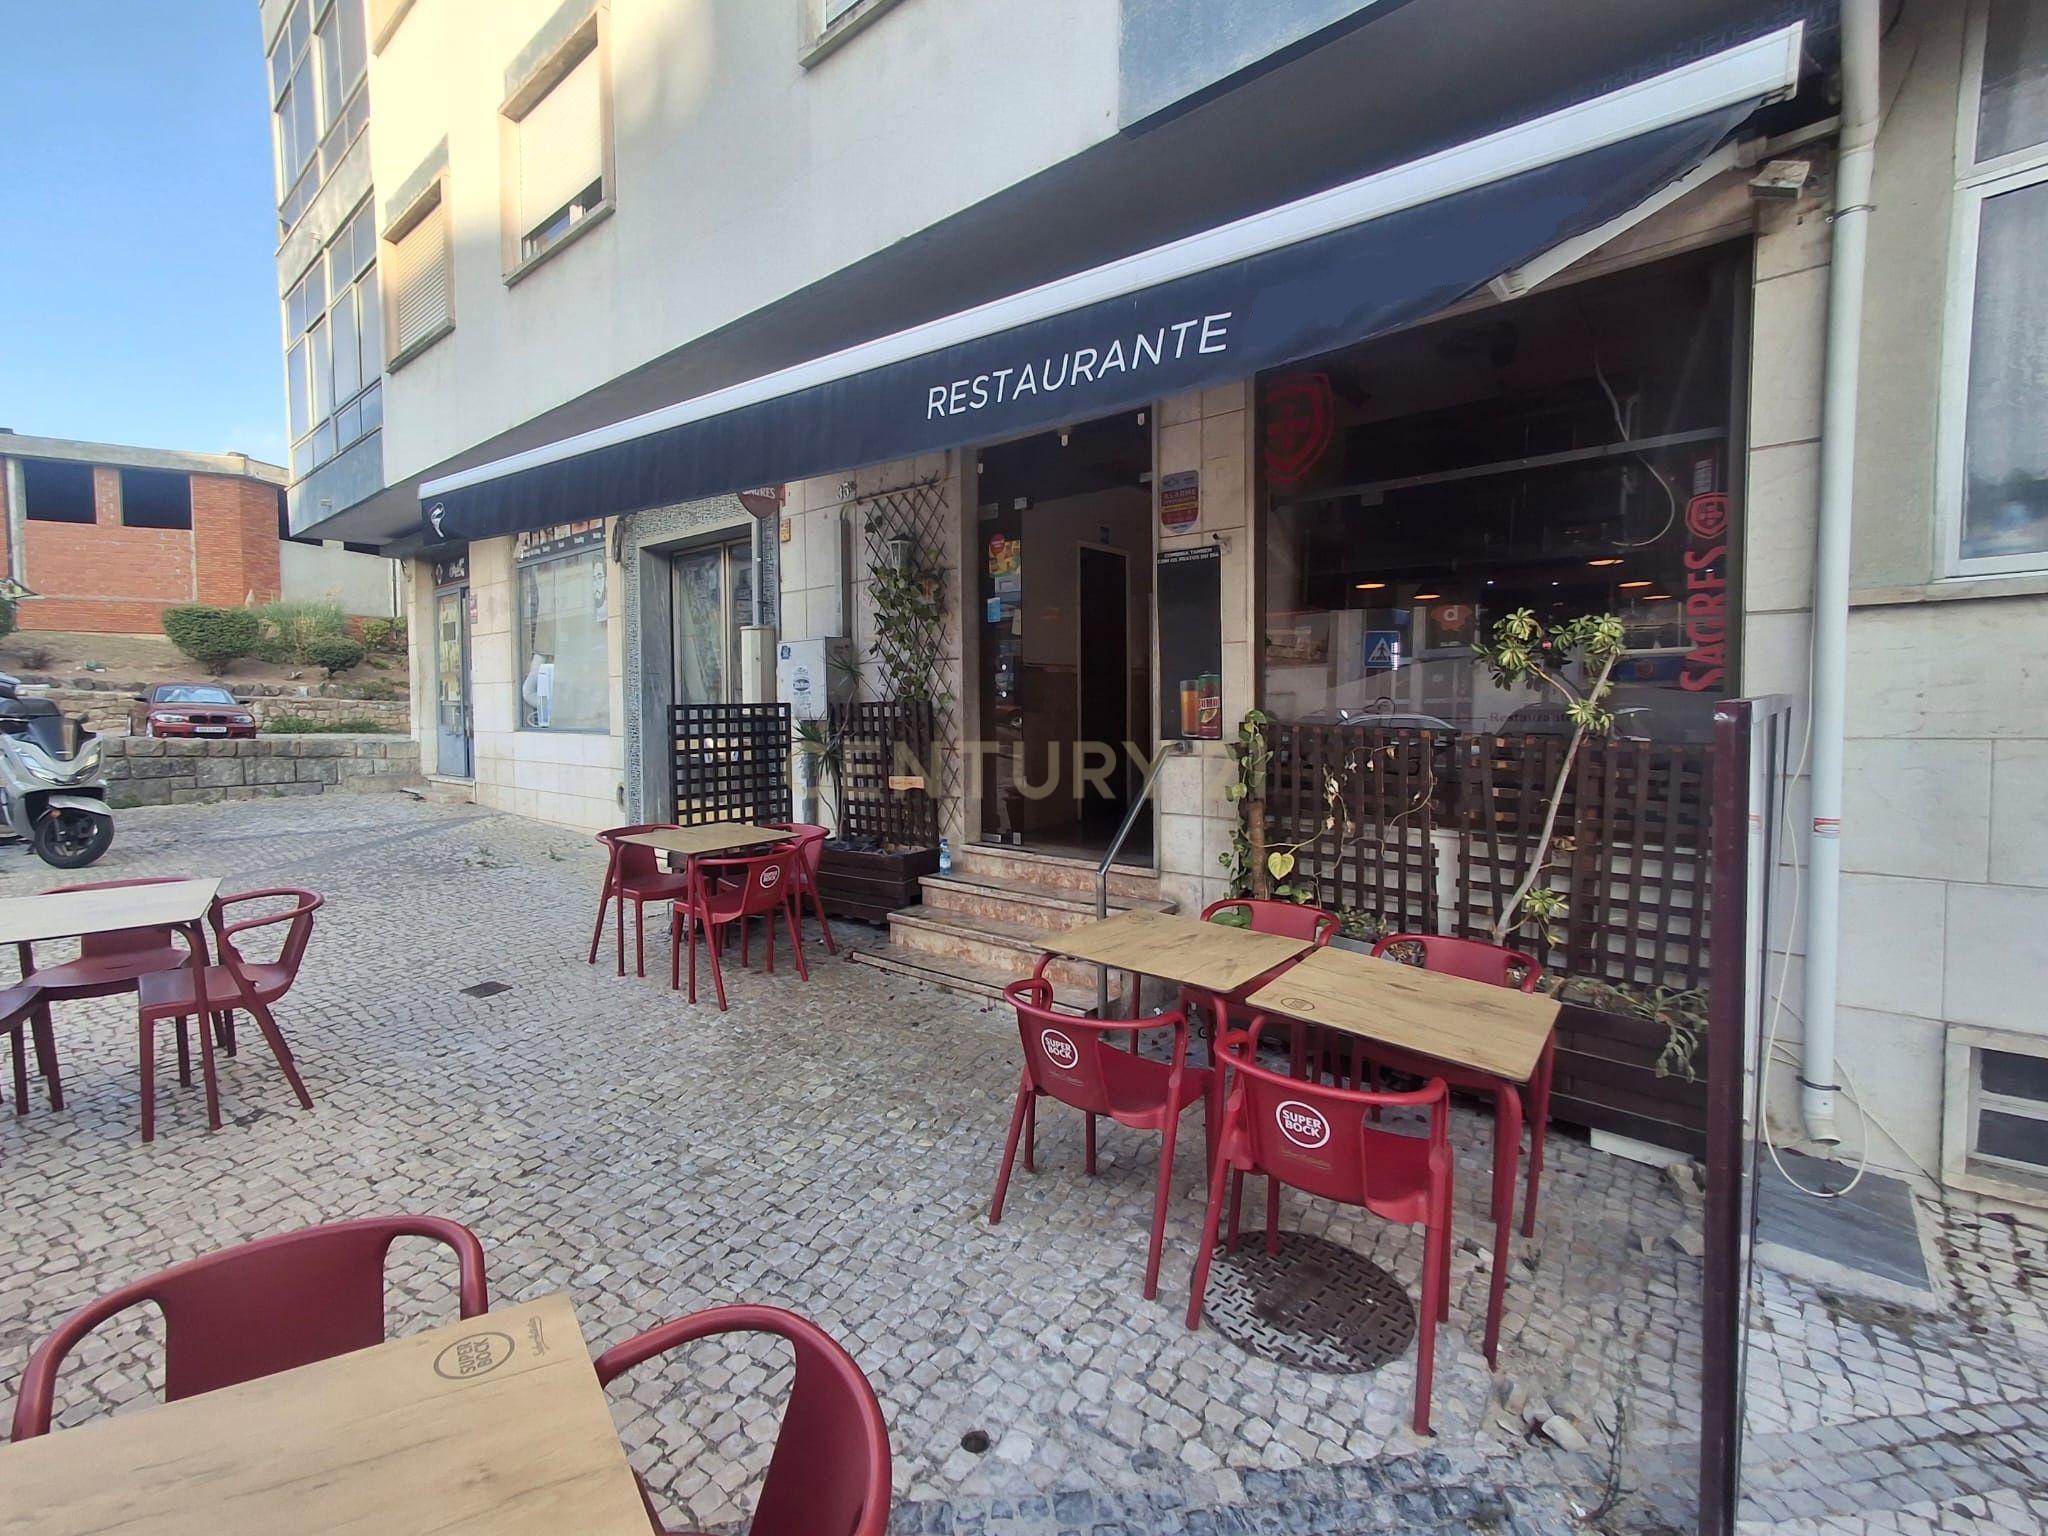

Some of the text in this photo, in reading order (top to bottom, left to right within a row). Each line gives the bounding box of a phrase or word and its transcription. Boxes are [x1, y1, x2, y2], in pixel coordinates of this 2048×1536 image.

[926, 311, 1233, 420] RESTAURANTE
[1679, 546, 1727, 692] SAGRES
[1045, 1036, 1071, 1052] SUPER
[1047, 1045, 1073, 1060] BOCK
[1281, 1109, 1322, 1129] SUPER
[1284, 1119, 1321, 1138] BOCK
[456, 1341, 477, 1375] SUPER
[473, 1337, 493, 1368] BOCK
